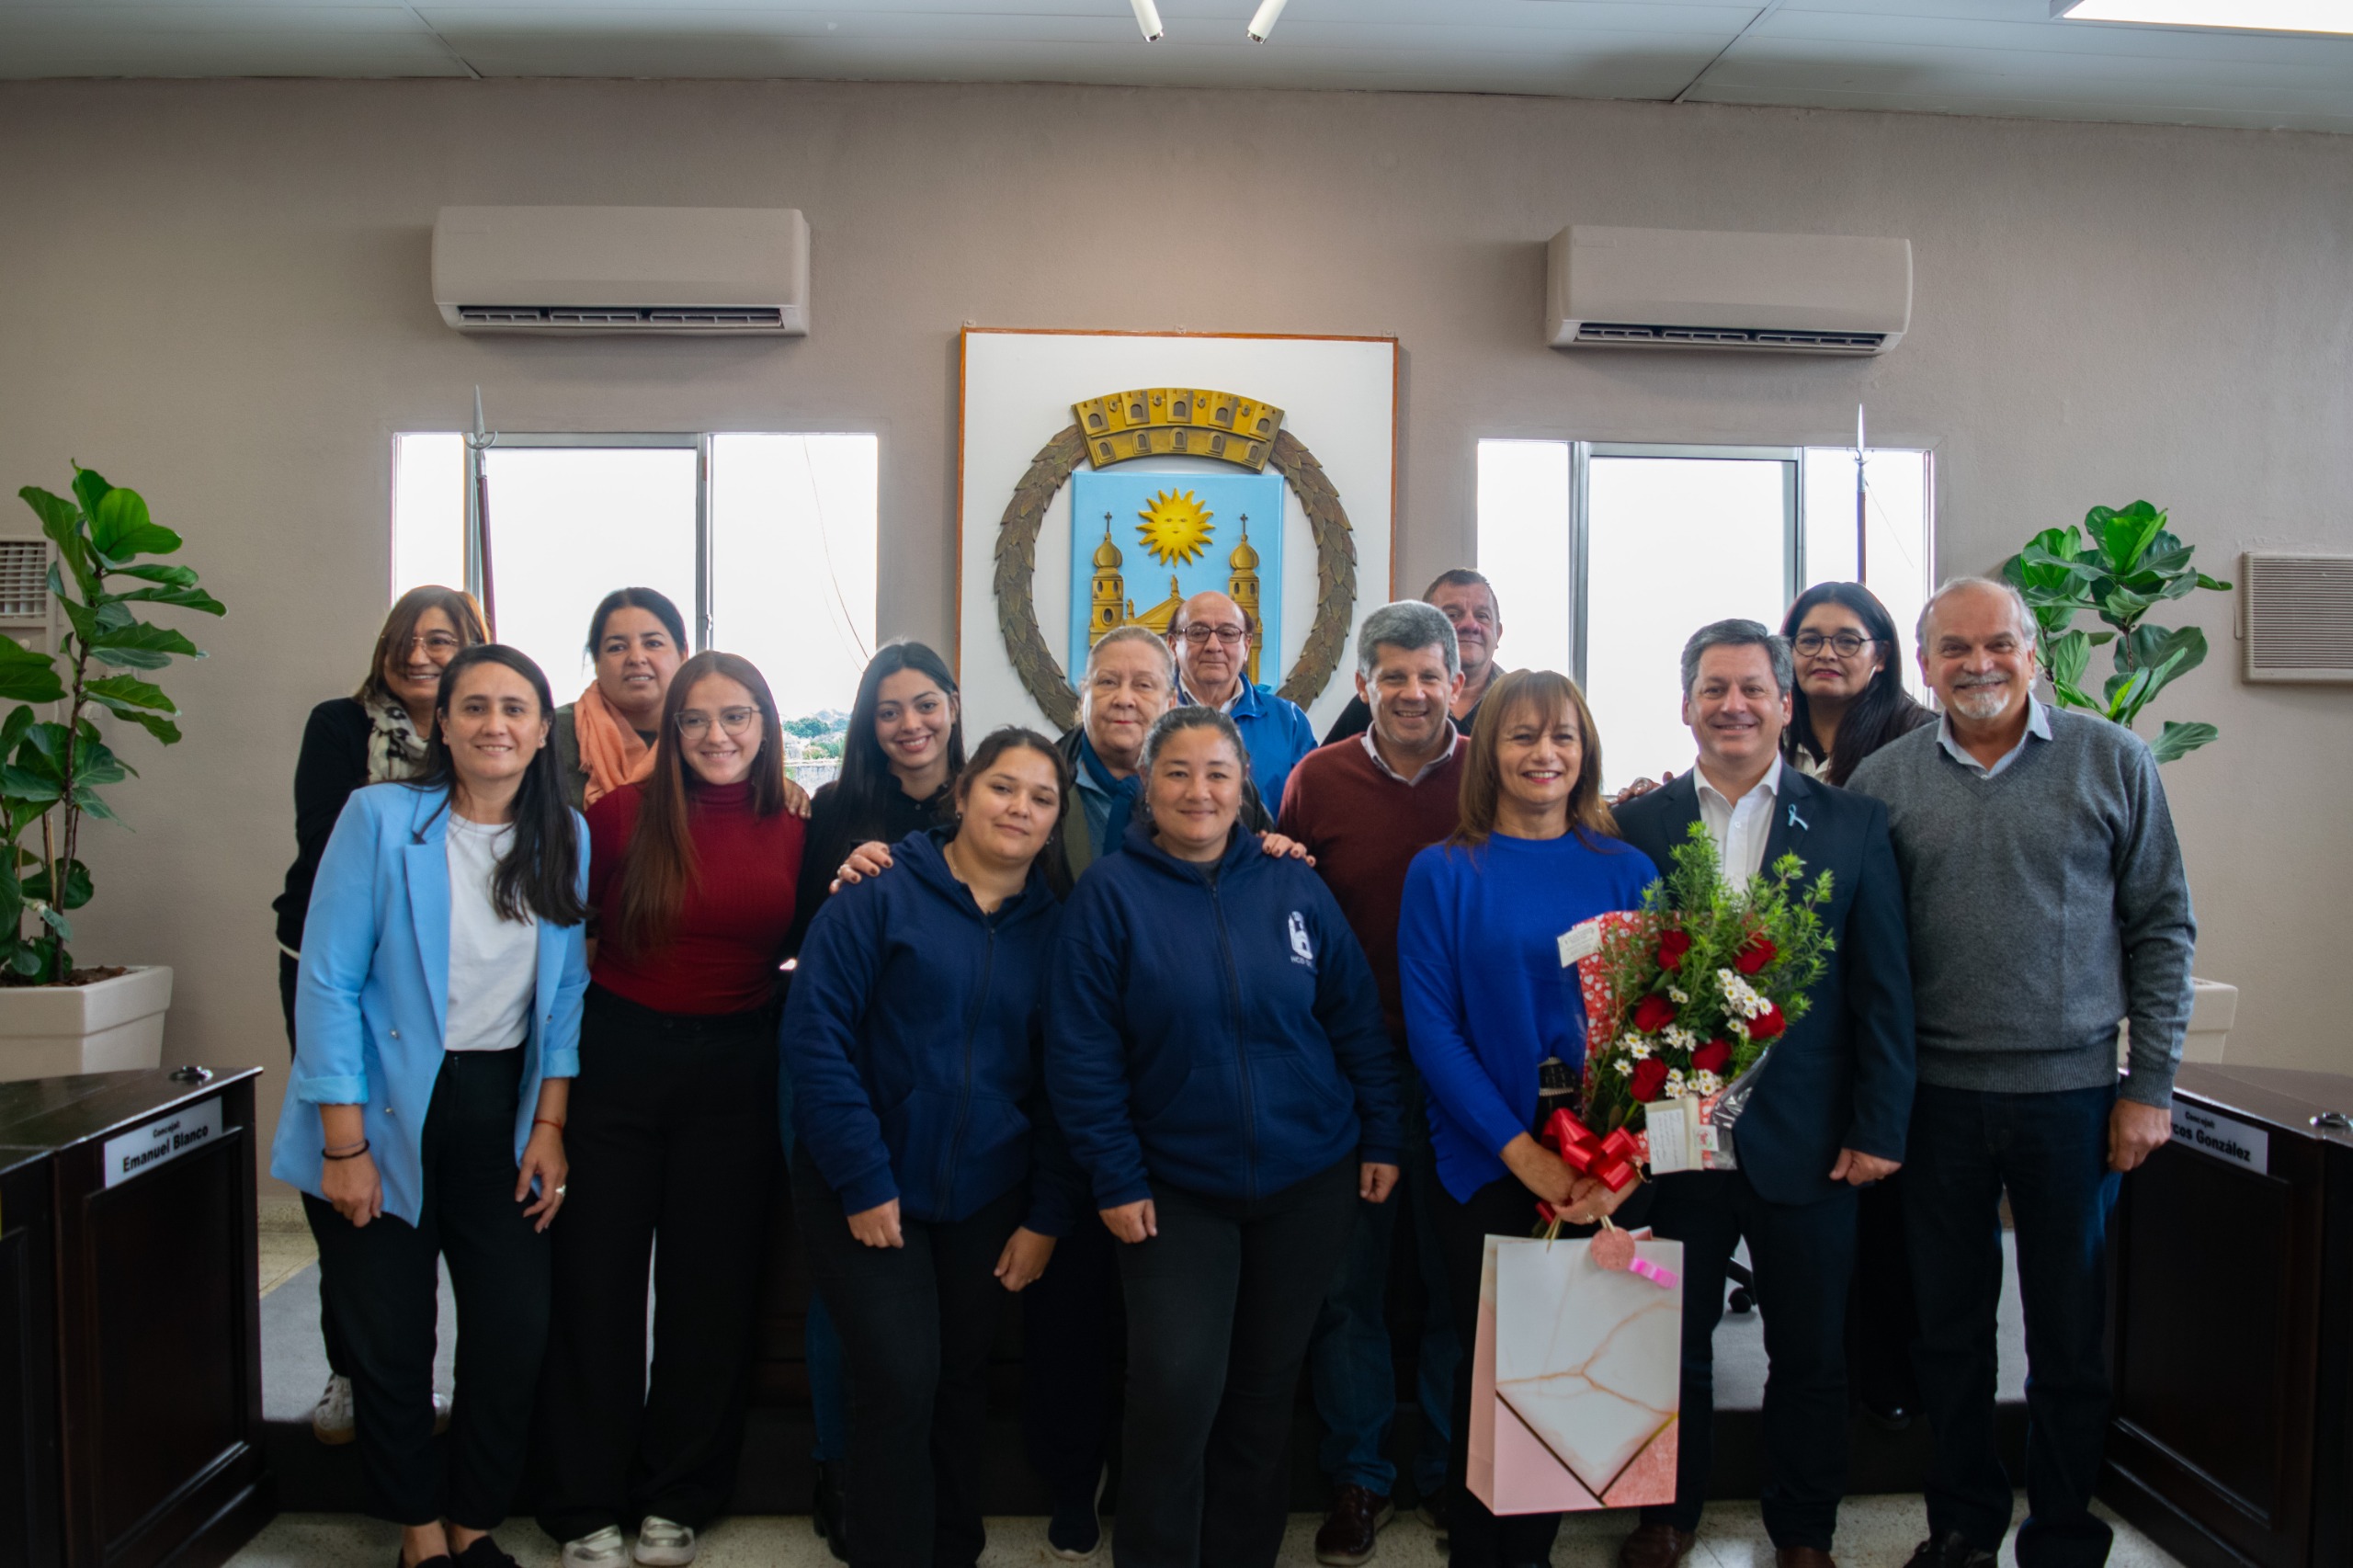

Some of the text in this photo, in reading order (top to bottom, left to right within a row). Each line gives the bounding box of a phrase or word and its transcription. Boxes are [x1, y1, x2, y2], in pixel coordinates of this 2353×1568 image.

[122, 1125, 209, 1174] Emanuel Blanco
[2171, 1123, 2251, 1163] cos González
